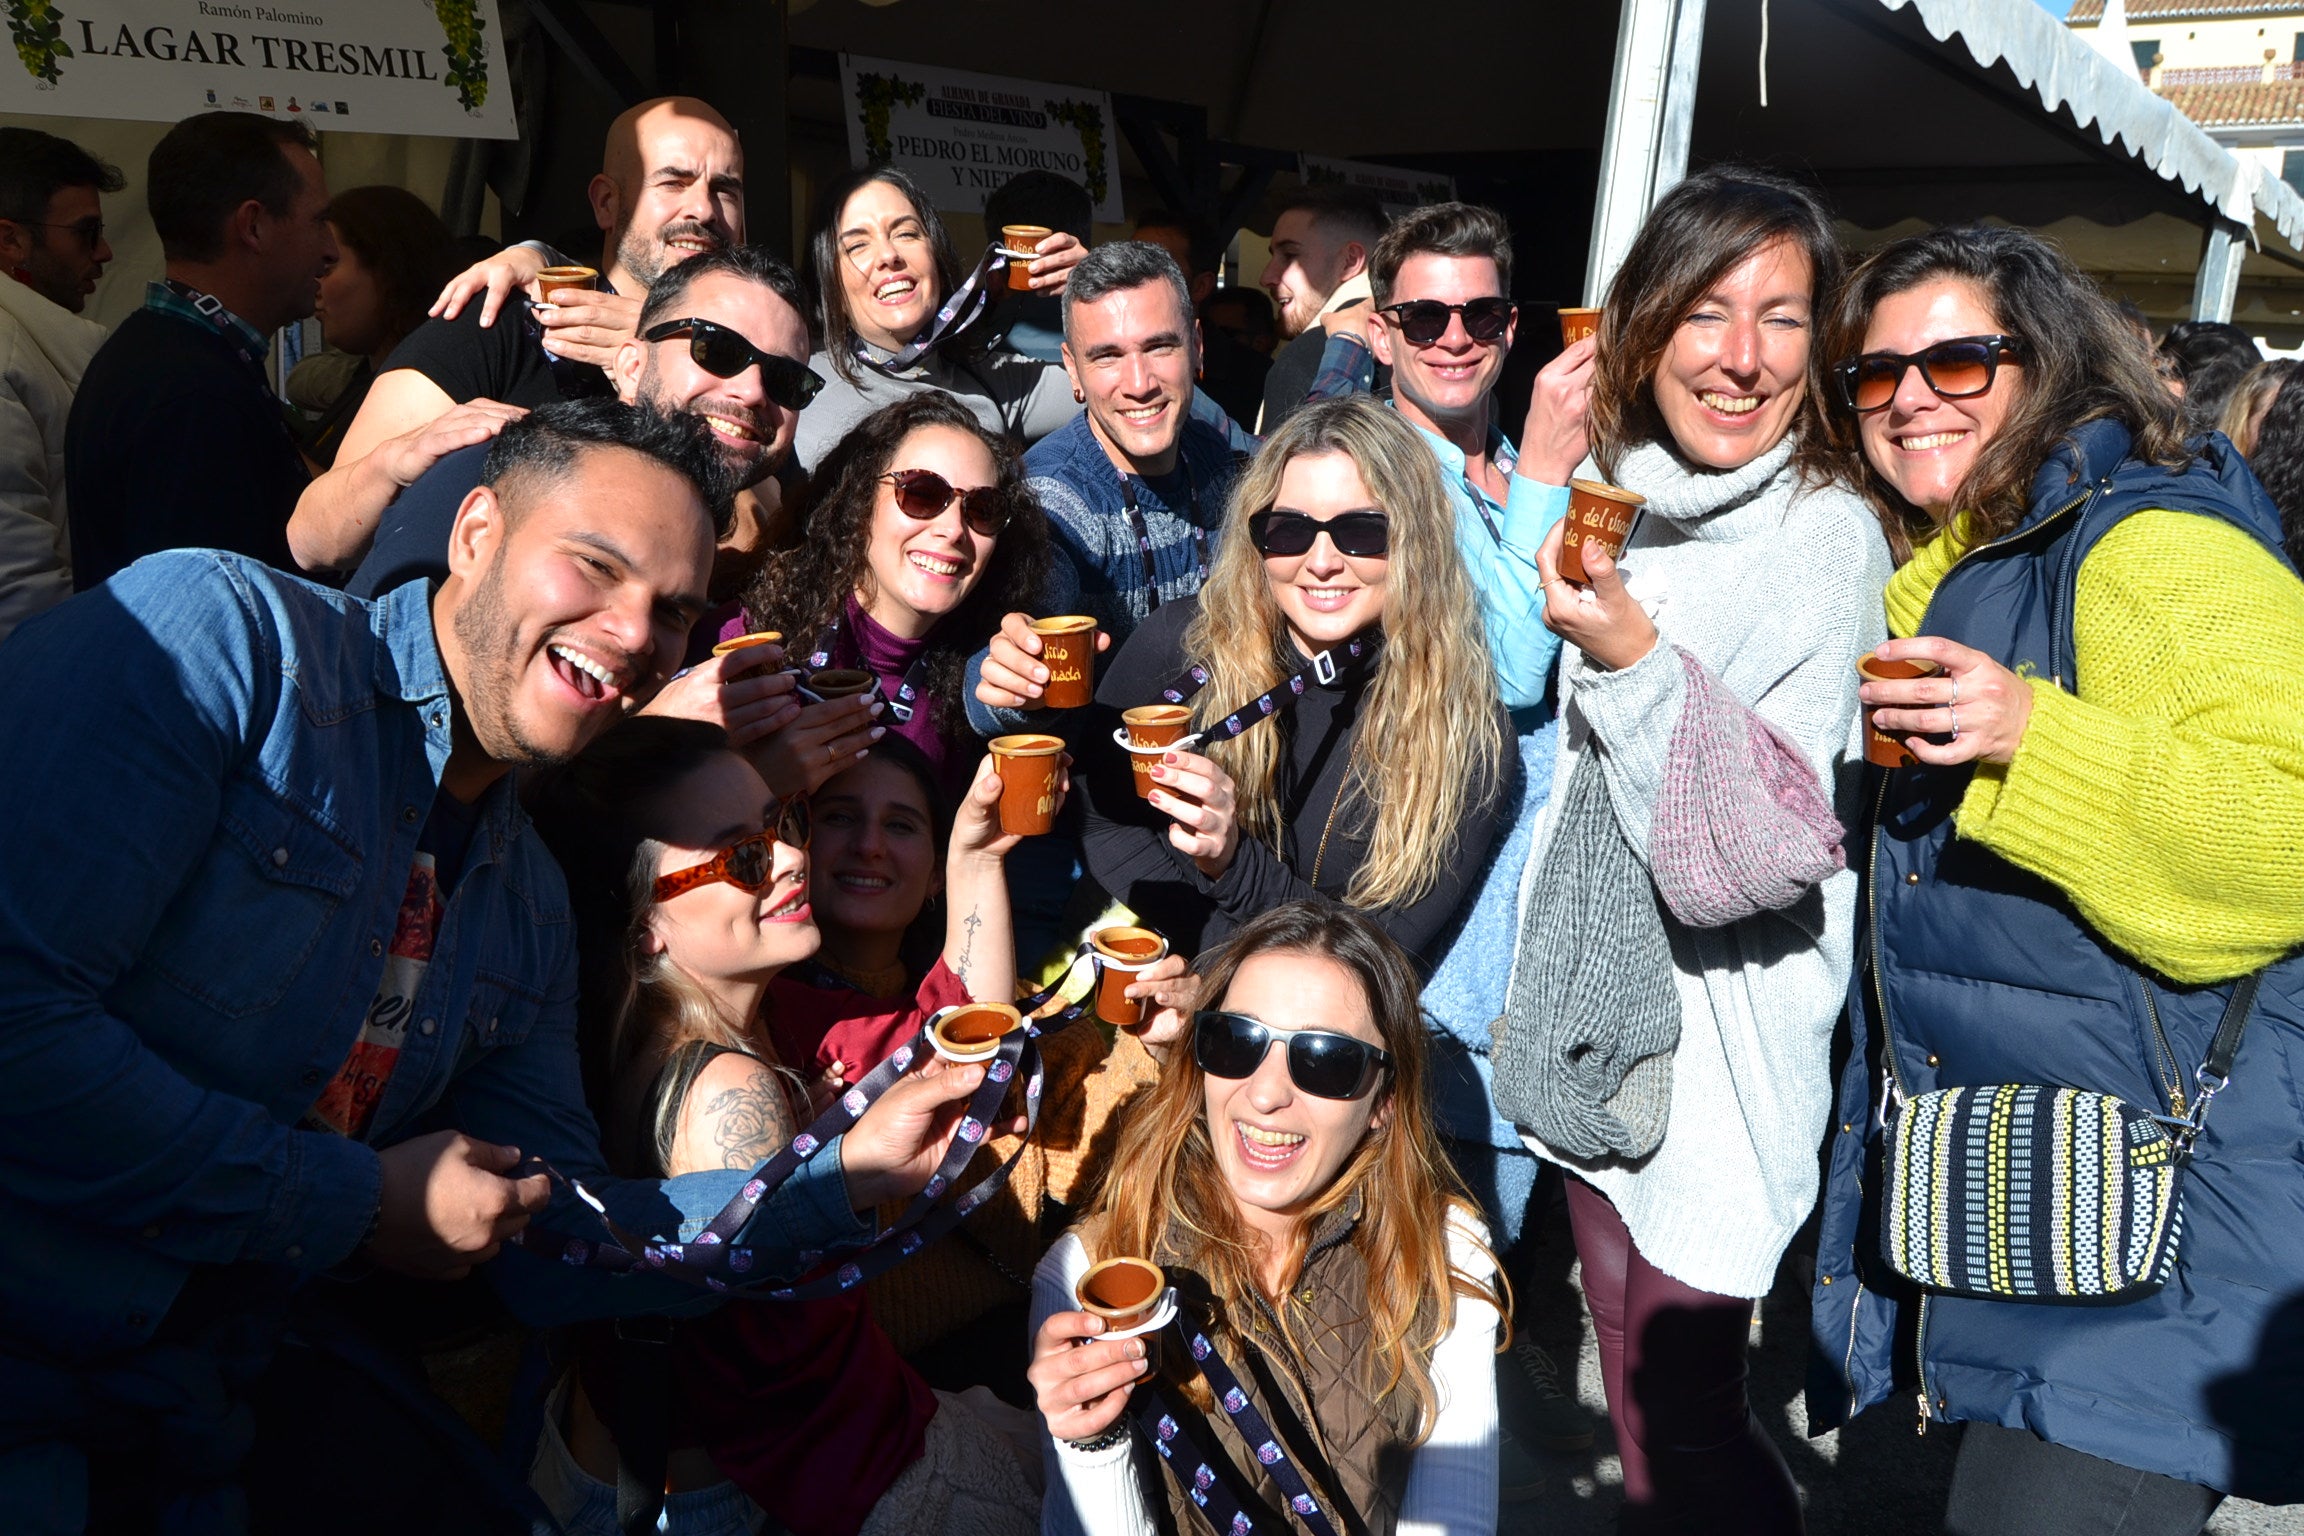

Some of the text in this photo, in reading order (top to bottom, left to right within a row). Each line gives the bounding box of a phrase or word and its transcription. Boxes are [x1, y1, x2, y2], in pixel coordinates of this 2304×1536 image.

[198, 1, 324, 26] Ramón Palomino
[77, 20, 438, 81] LAGAR TRESMIL
[942, 85, 1031, 109] ALHAMA DE GRANADA
[931, 101, 1044, 129] FIESTA DEL VINO
[897, 135, 1080, 172] PEDRO EL MORUNO
[950, 166, 1016, 188] Y NIET
[1582, 506, 1609, 529] del
[1564, 527, 1579, 548] de
